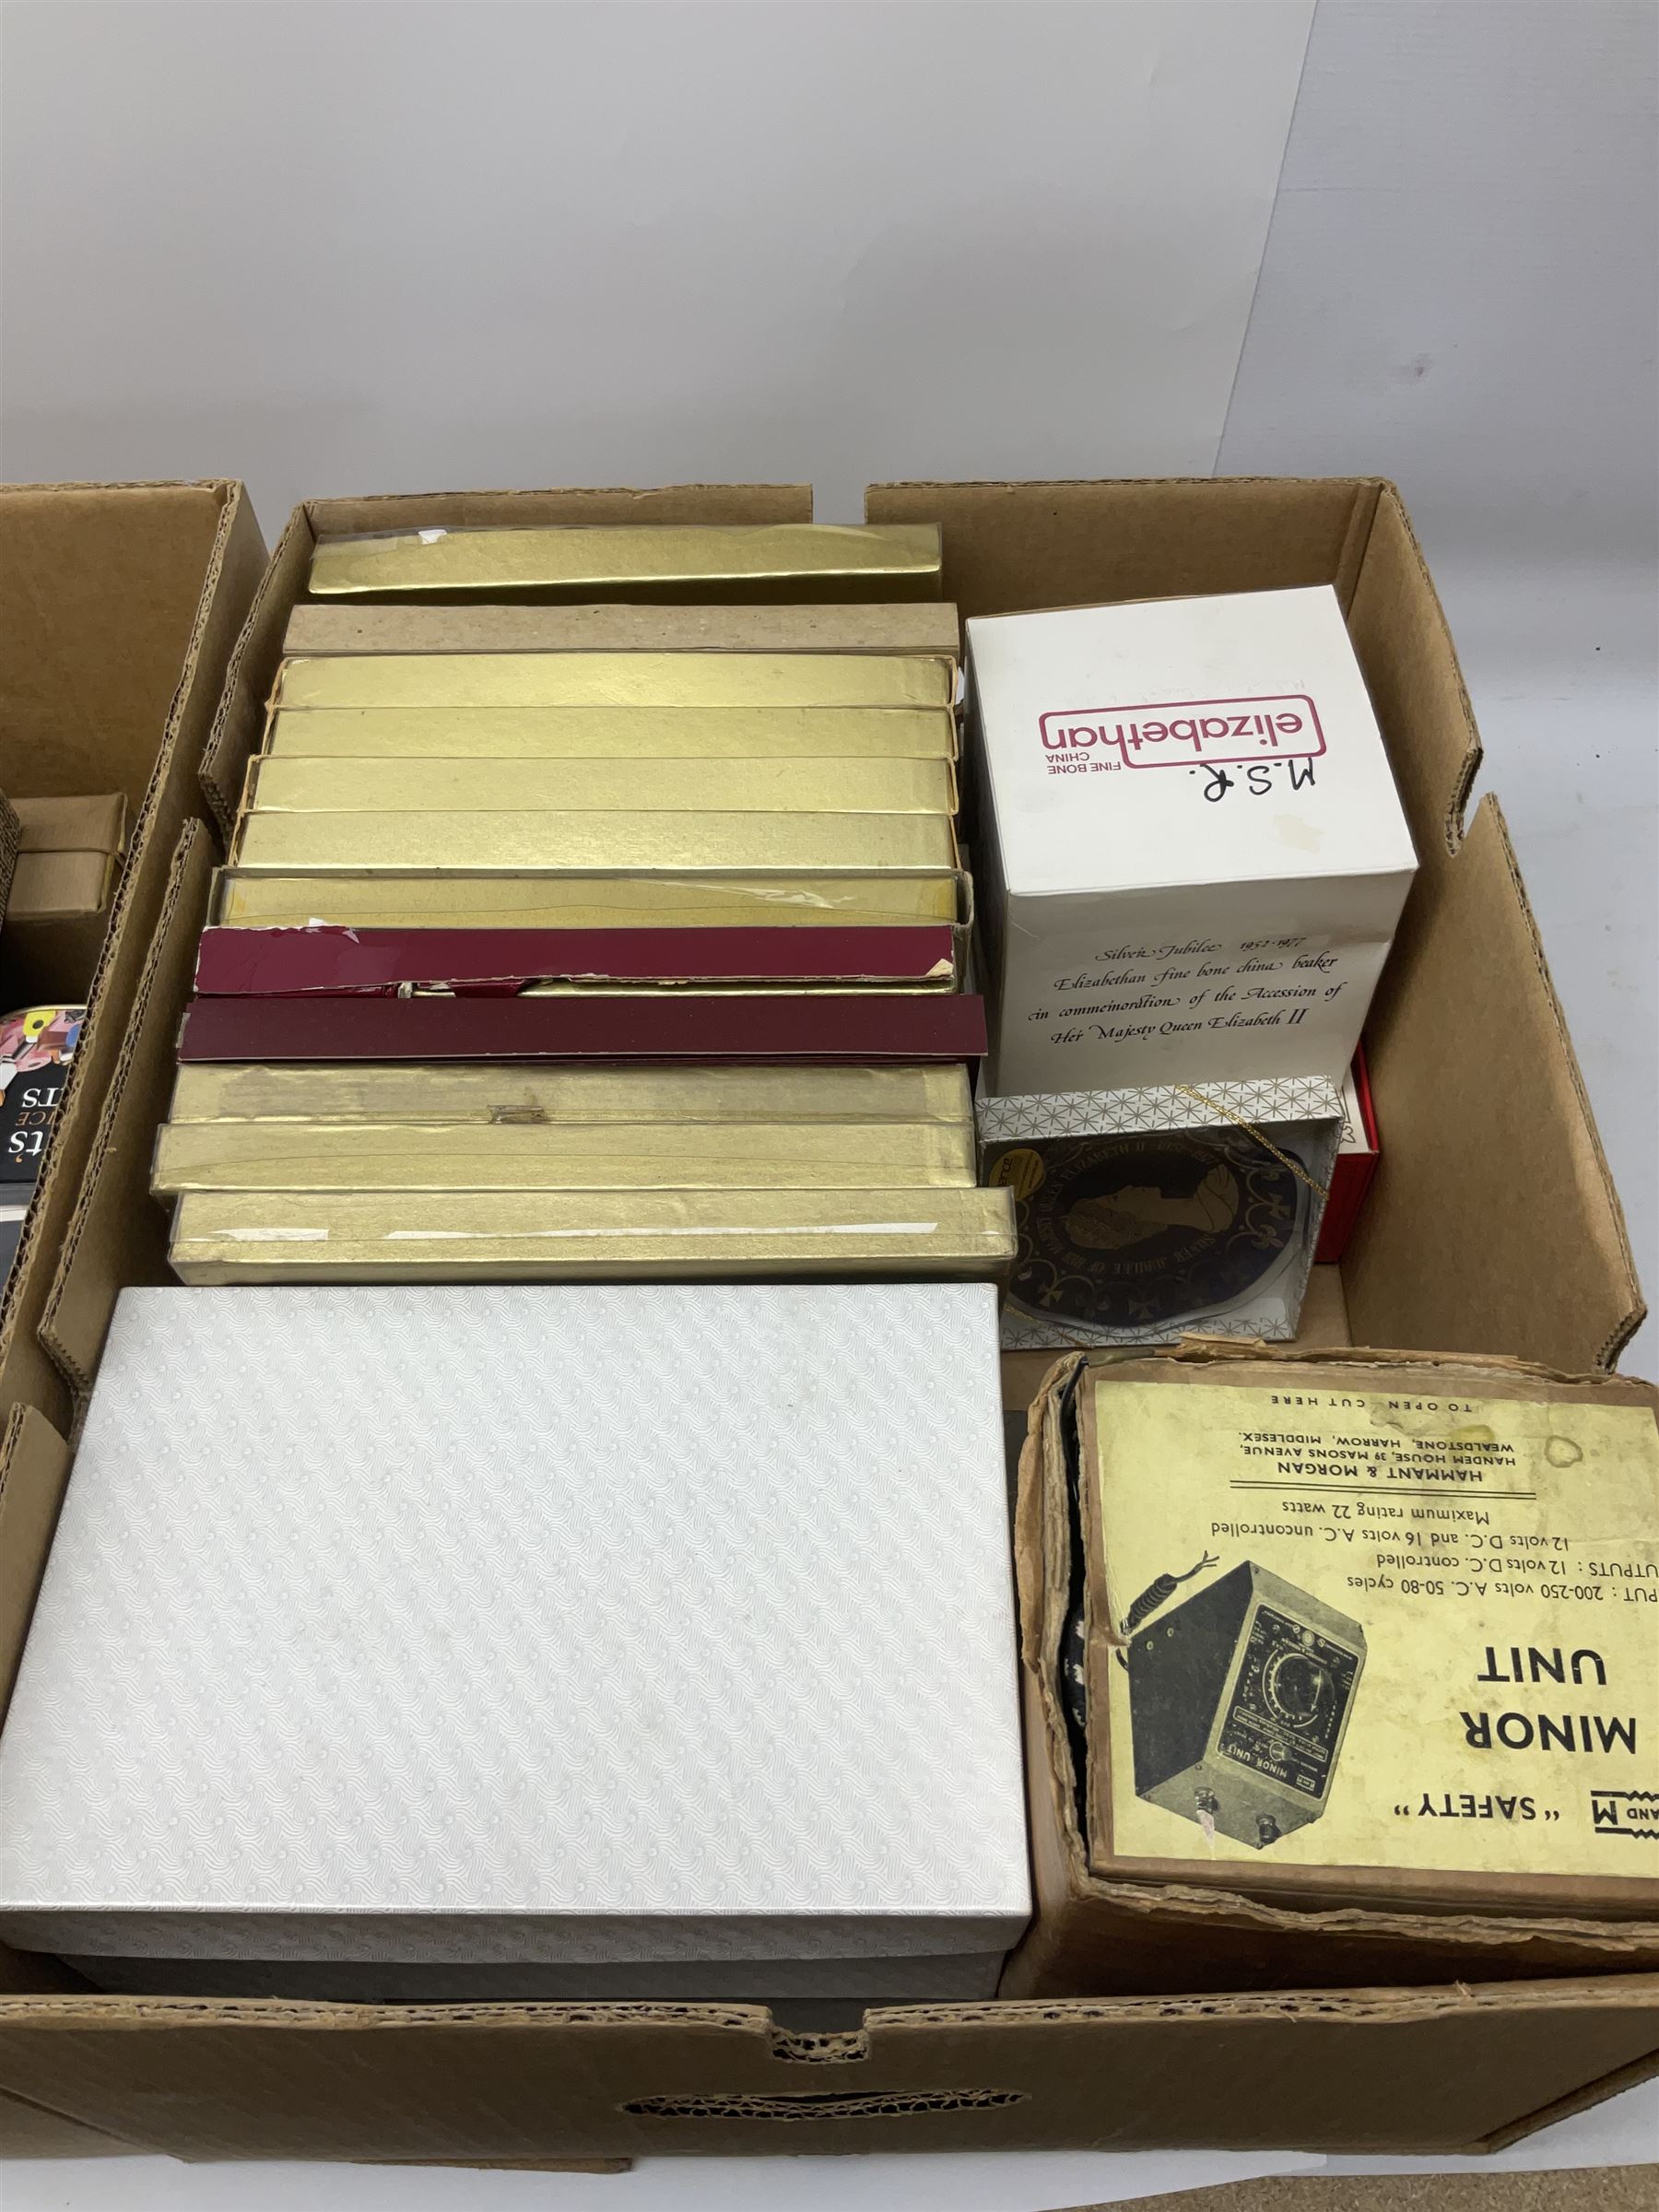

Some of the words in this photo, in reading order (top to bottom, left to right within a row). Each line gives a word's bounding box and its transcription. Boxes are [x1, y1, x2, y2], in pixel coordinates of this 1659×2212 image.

[1039, 712, 1303, 752] elizabethan
[1045, 752, 1089, 762] CHINA
[1047, 764, 1087, 774] BONE
[1092, 761, 1121, 772] FINE
[1095, 945, 1156, 961] Silver
[1157, 939, 1221, 959] Jubilee
[1054, 971, 1146, 990] Elizabethan
[1150, 966, 1191, 987] fine
[1196, 961, 1230, 977] bone
[1236, 958, 1283, 972] china
[1292, 951, 1337, 973] beaker
[1029, 1008, 1048, 1020] in
[1059, 994, 1180, 1017] commemoration
[1189, 989, 1210, 1009] of
[1215, 985, 1236, 1001] the
[1241, 985, 1316, 999] Accession
[1324, 982, 1347, 1002] of
[1051, 1028, 1083, 1043] Her
[1088, 1025, 1156, 1042] Majesty
[1159, 1022, 1202, 1035] Queen
[1208, 1010, 1286, 1028] Elizabeth
[1288, 1008, 1309, 1024] II
[998, 1158, 1013, 1186] ance
[1272, 1396, 1317, 1406] HERE
[1329, 1398, 1365, 1407] CUT
[1389, 1402, 1438, 1410] OPEN
[1449, 1404, 1472, 1412] TO
[1239, 1433, 1321, 1443] MIDDLESEX.
[1333, 1436, 1400, 1447] HARROW,
[1241, 1445, 1301, 1456] AVENUE,
[1413, 1440, 1513, 1452] WEALDSTONE,
[1309, 1450, 1368, 1459] MASONS
[1375, 1453, 1386, 1461] 39
[1393, 1452, 1445, 1463] HOUSE,
[1453, 1456, 1515, 1465] HANDEM
[1278, 1463, 1357, 1476] MORGAN
[1367, 1466, 1377, 1477] &
[1387, 1468, 1482, 1481] HAMMANT
[1283, 1502, 1325, 1512] watts
[1332, 1505, 1351, 1519] 22
[1357, 1502, 1403, 1517] rating
[1411, 1509, 1488, 1524] Maximum
[1212, 1523, 1312, 1536] uncontrolled
[1320, 1528, 1354, 1542] A.C.
[1362, 1530, 1400, 1542] volts
[1406, 1533, 1421, 1546] 16
[1430, 1534, 1458, 1547] and
[1465, 1535, 1502, 1548] D.C.
[1511, 1535, 1547, 1549] volts
[1552, 1537, 1568, 1551] 12
[1377, 1555, 1459, 1569] controlled
[1465, 1559, 1501, 1572] D.C.
[1507, 1559, 1546, 1573] volts
[1548, 1561, 1565, 1574] 12
[1347, 1574, 1394, 1592] cycles
[1402, 1580, 1443, 1594] 50-80
[1452, 1582, 1487, 1595] A.C.
[1495, 1583, 1534, 1597] volts
[1541, 1584, 1603, 1600] 200-250
[1477, 1647, 1606, 1685] UNIT
[1460, 1712, 1635, 1754] MINOR
[1592, 1800, 1618, 1825] M
